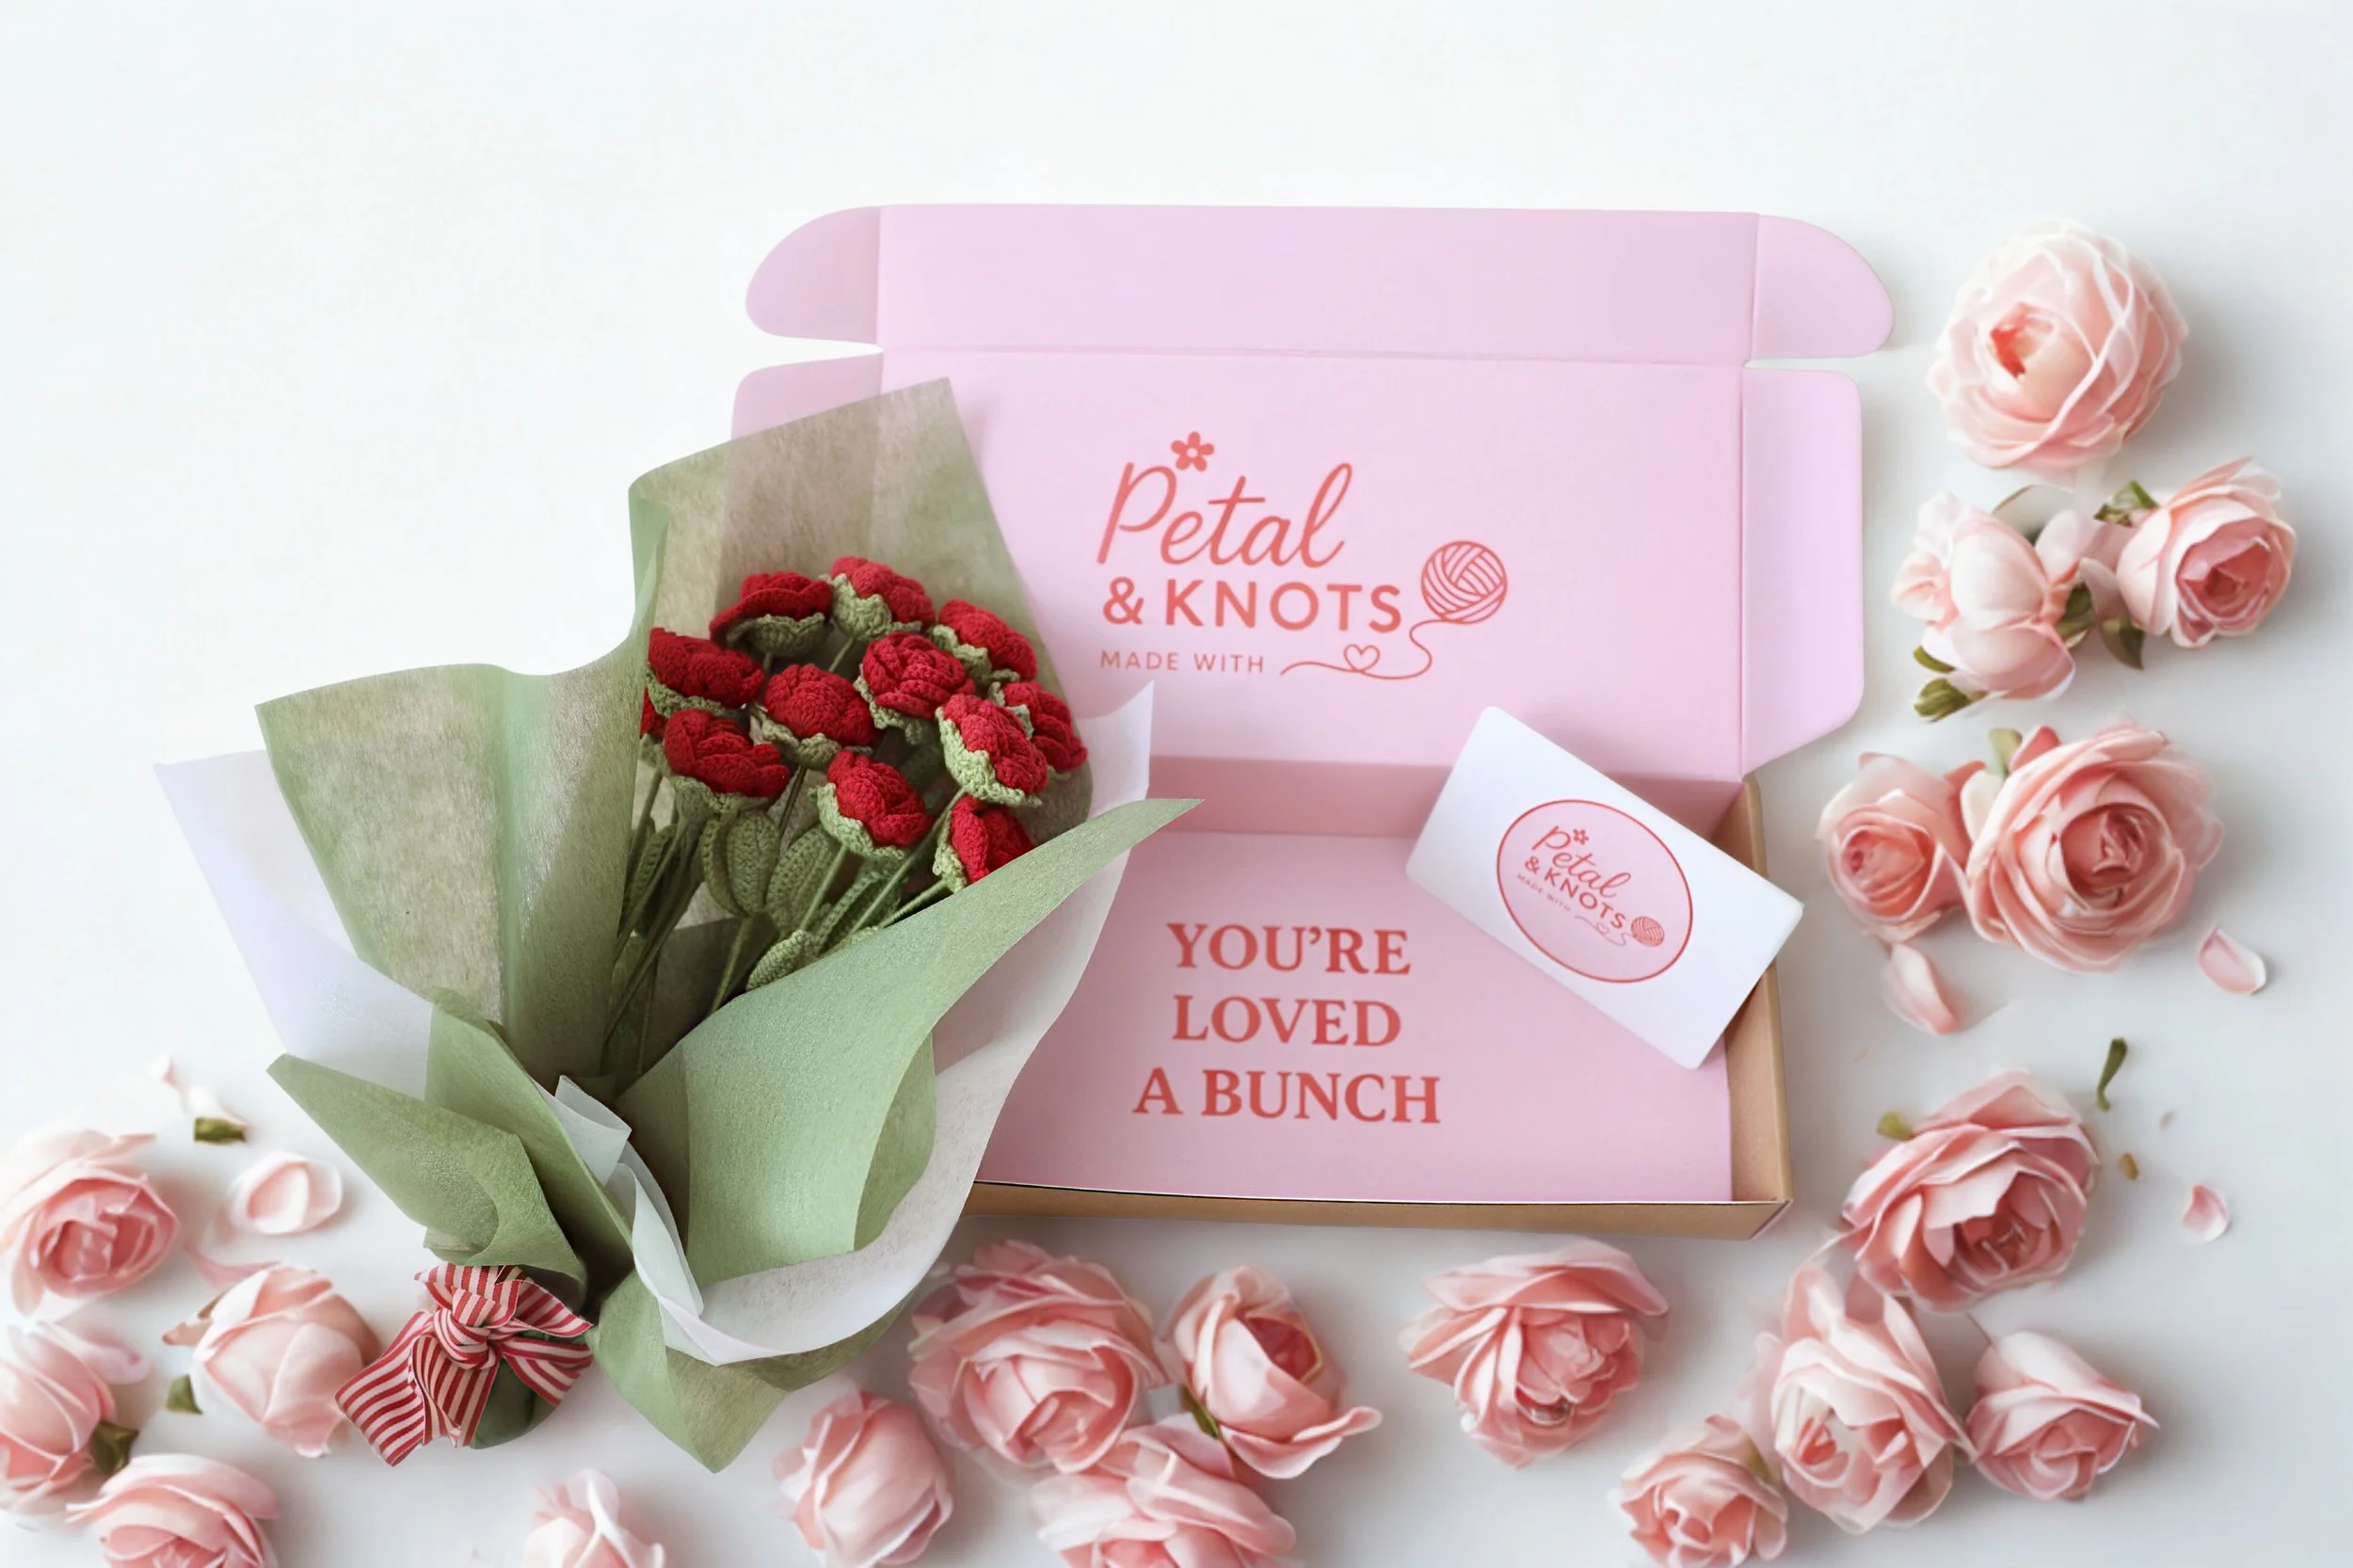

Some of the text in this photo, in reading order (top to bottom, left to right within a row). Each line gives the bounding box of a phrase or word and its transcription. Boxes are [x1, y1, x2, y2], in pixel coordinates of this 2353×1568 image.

[1096, 462, 1353, 568] Petal
[1102, 576, 1402, 633] & KNOTS
[1099, 650, 1265, 673] MADE WITH
[1530, 825, 1632, 899] Petal
[1517, 872, 1571, 912] MADE WITH
[1524, 856, 1626, 930] & KNOTS
[1172, 994, 1401, 1047] LOVED
[1132, 1066, 1441, 1124] A BUNCH
